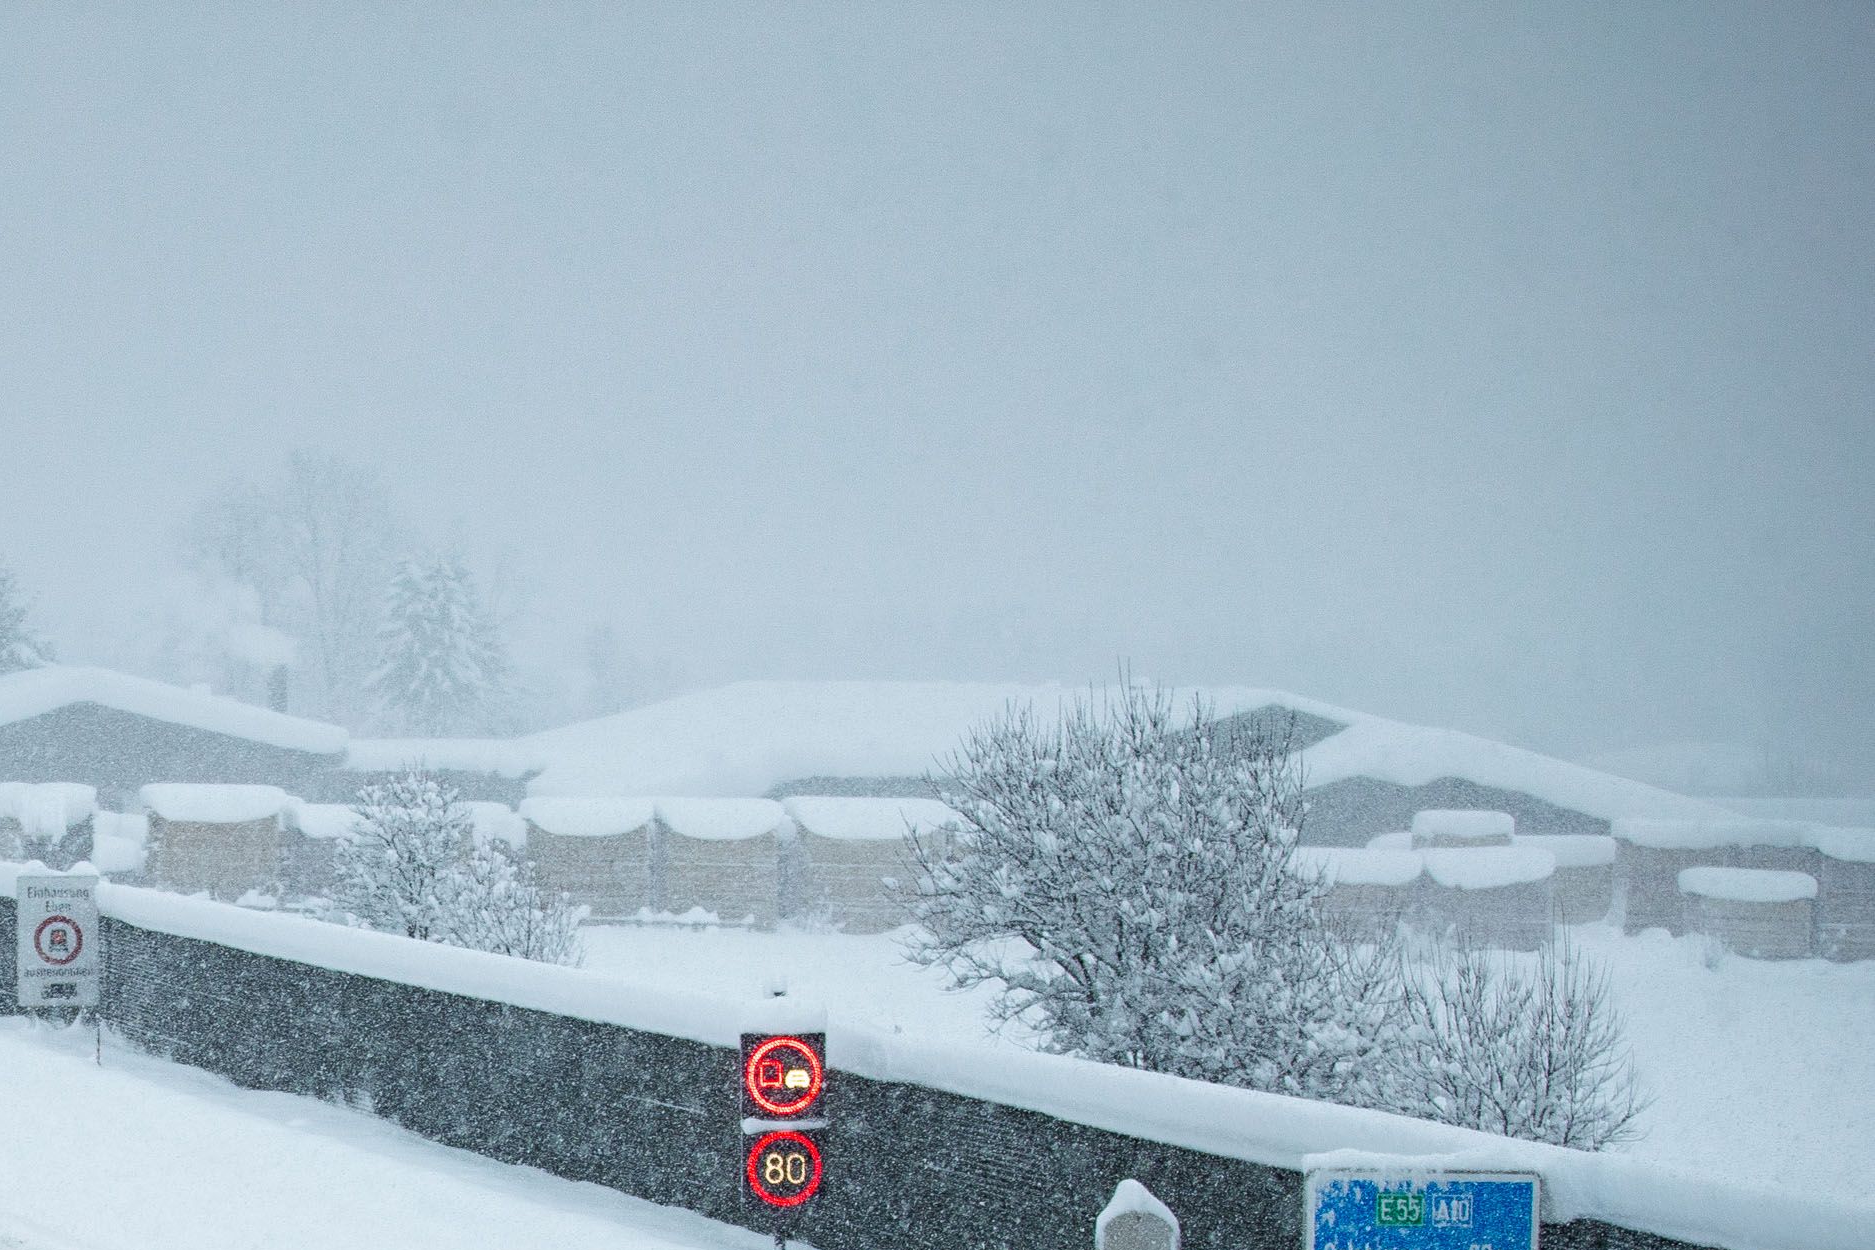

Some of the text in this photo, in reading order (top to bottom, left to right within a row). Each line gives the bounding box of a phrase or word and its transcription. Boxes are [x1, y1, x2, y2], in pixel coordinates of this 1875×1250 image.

[764, 1153, 806, 1184] 80
[1381, 1200, 1420, 1221] E 55
